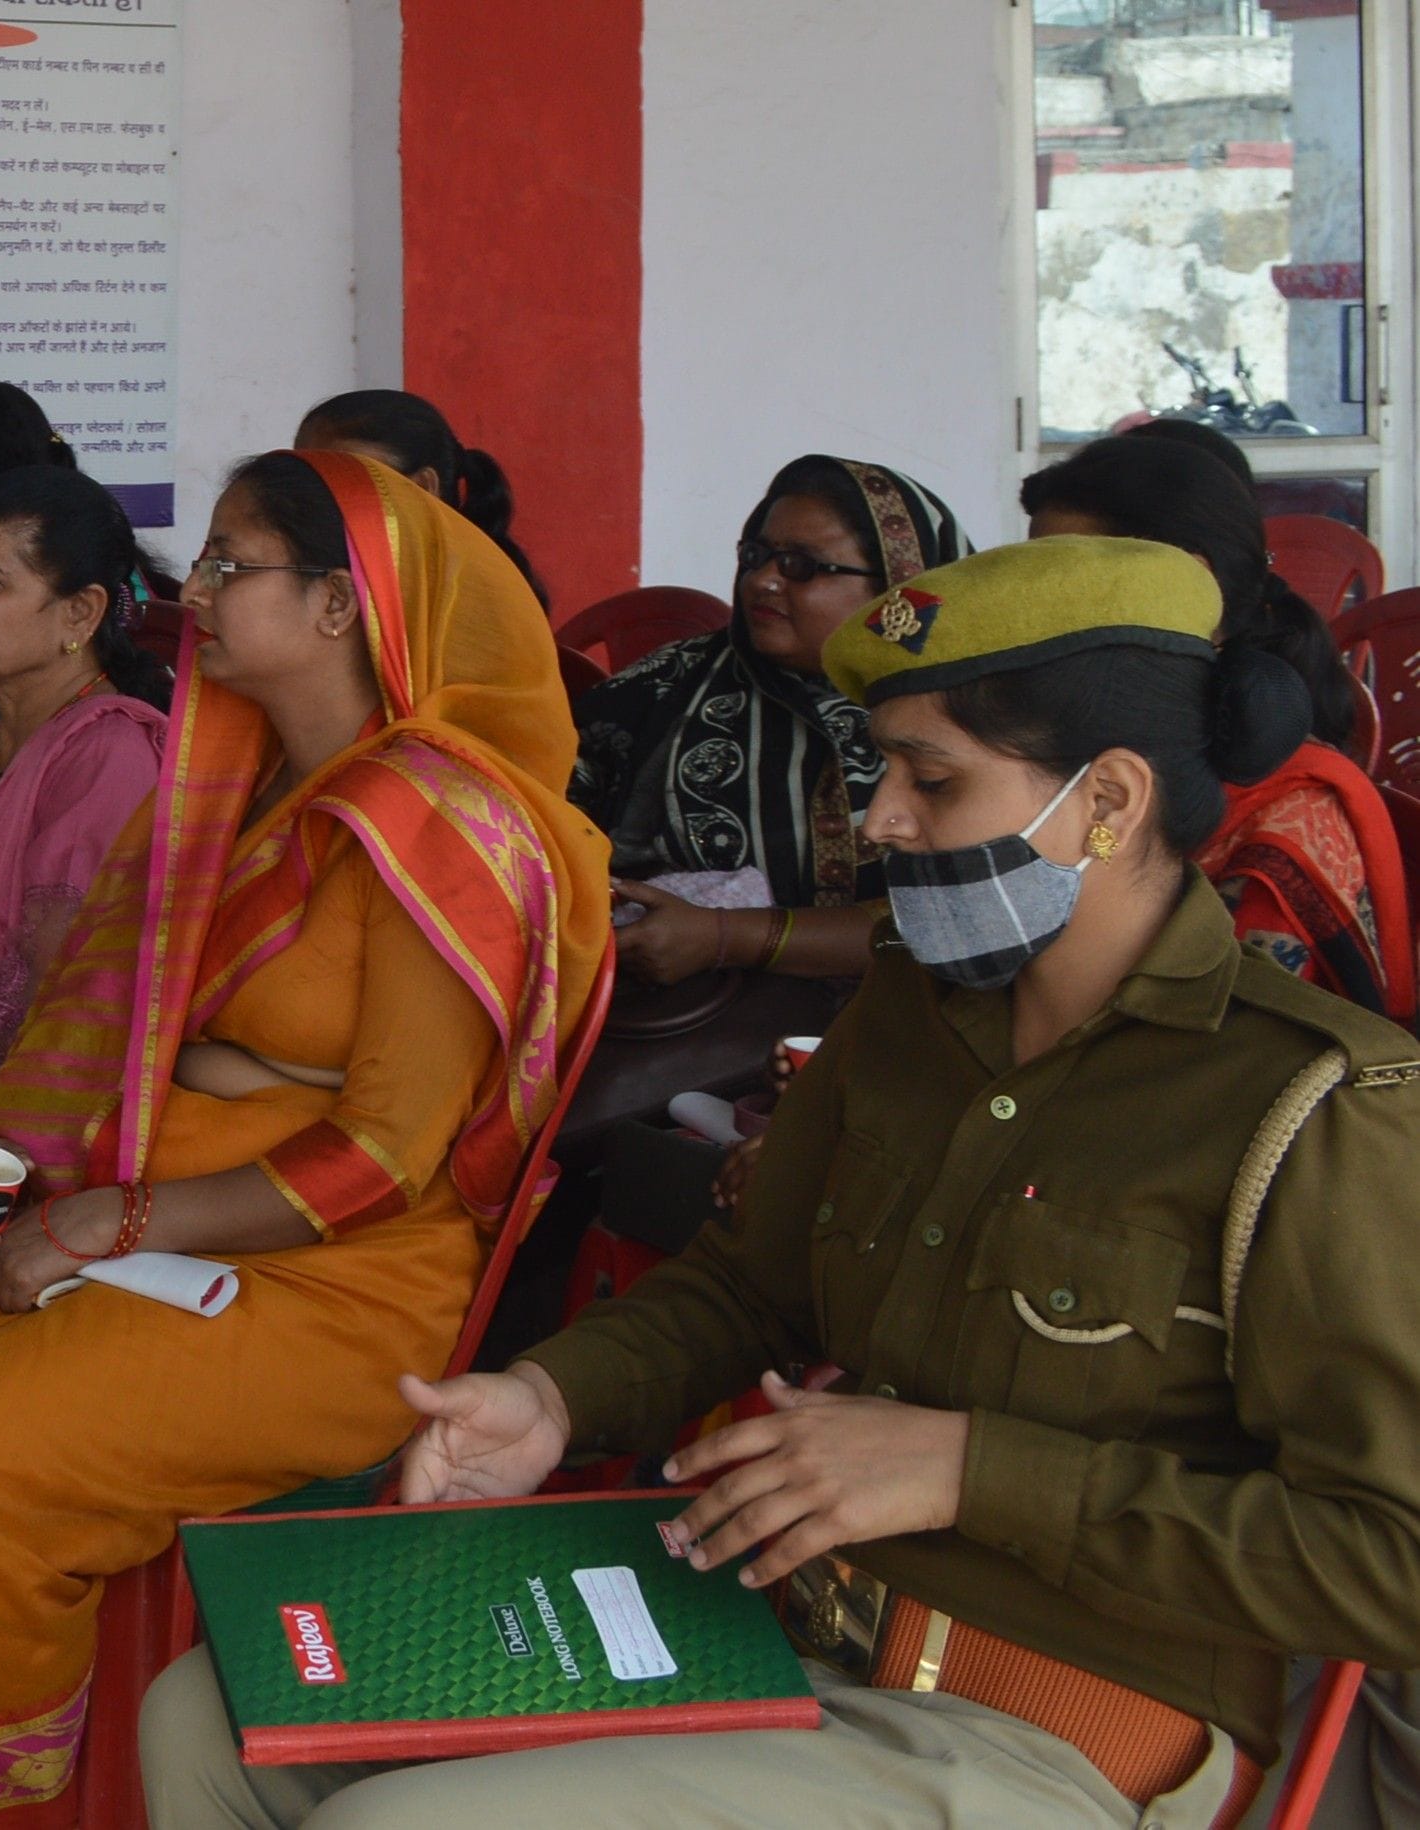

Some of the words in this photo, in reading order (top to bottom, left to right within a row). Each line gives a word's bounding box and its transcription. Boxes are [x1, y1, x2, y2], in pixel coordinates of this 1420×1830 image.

[501, 1608, 528, 1653] Deluxe
[526, 1576, 566, 1643] NOTEBOOK
[294, 1609, 336, 1681] Rajeev
[553, 1644, 582, 1680] LONG
